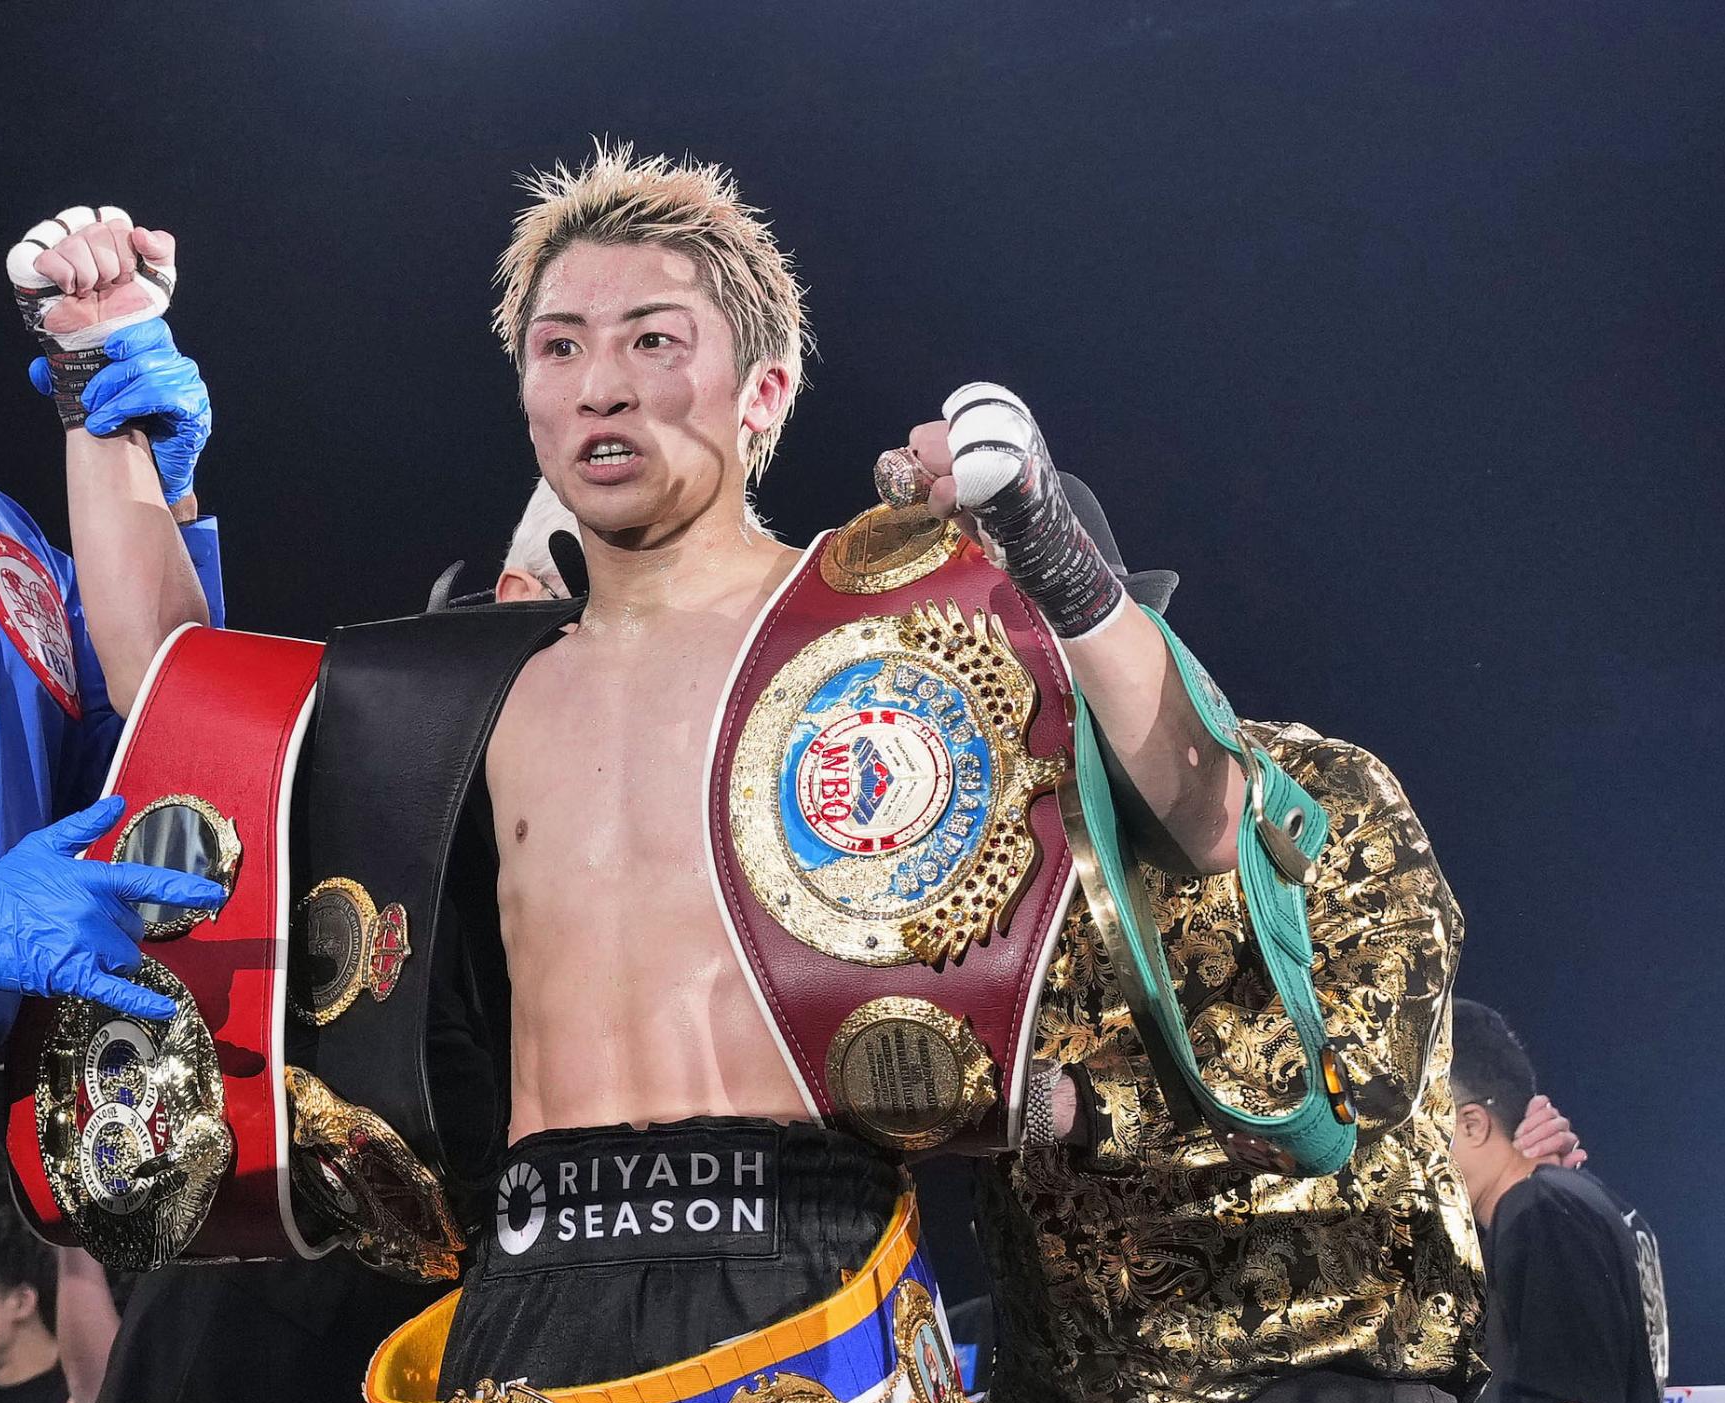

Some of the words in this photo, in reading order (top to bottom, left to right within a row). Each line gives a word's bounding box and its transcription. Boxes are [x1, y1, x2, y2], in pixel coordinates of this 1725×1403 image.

[821, 743, 853, 824] WBO
[85, 1028, 111, 1106] Champion
[154, 1110, 168, 1147] IBF
[558, 1151, 765, 1196] RIYADH
[557, 1197, 765, 1242] SEASON
